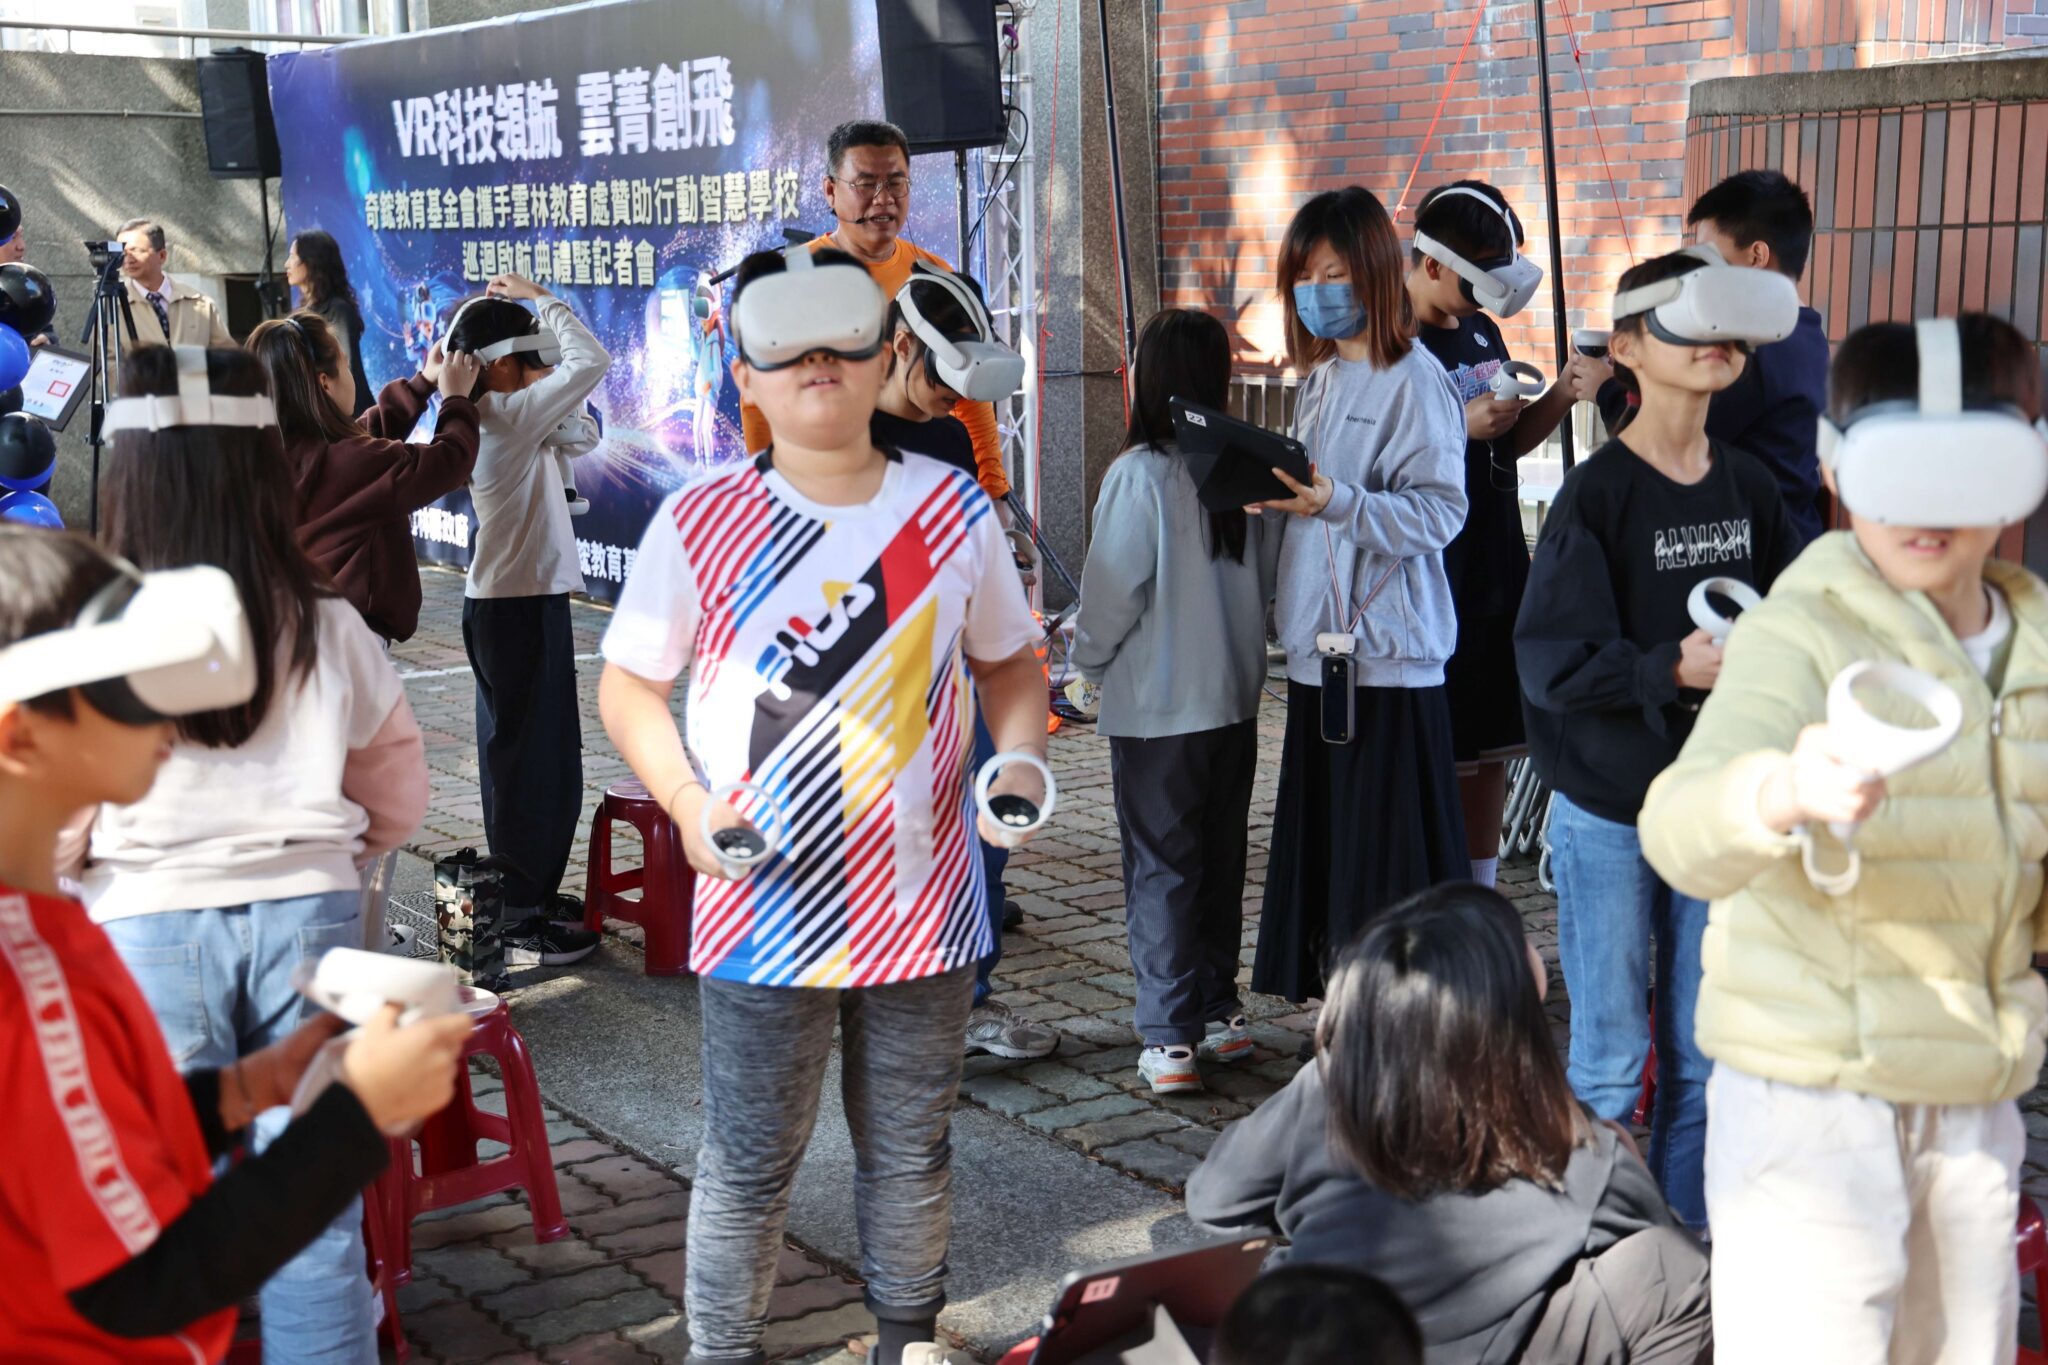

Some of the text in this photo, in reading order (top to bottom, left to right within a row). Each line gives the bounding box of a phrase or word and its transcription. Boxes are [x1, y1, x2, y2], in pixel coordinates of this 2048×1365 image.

[393, 55, 735, 166] VR科技領航 雲菁創飛
[756, 580, 876, 701] FILA
